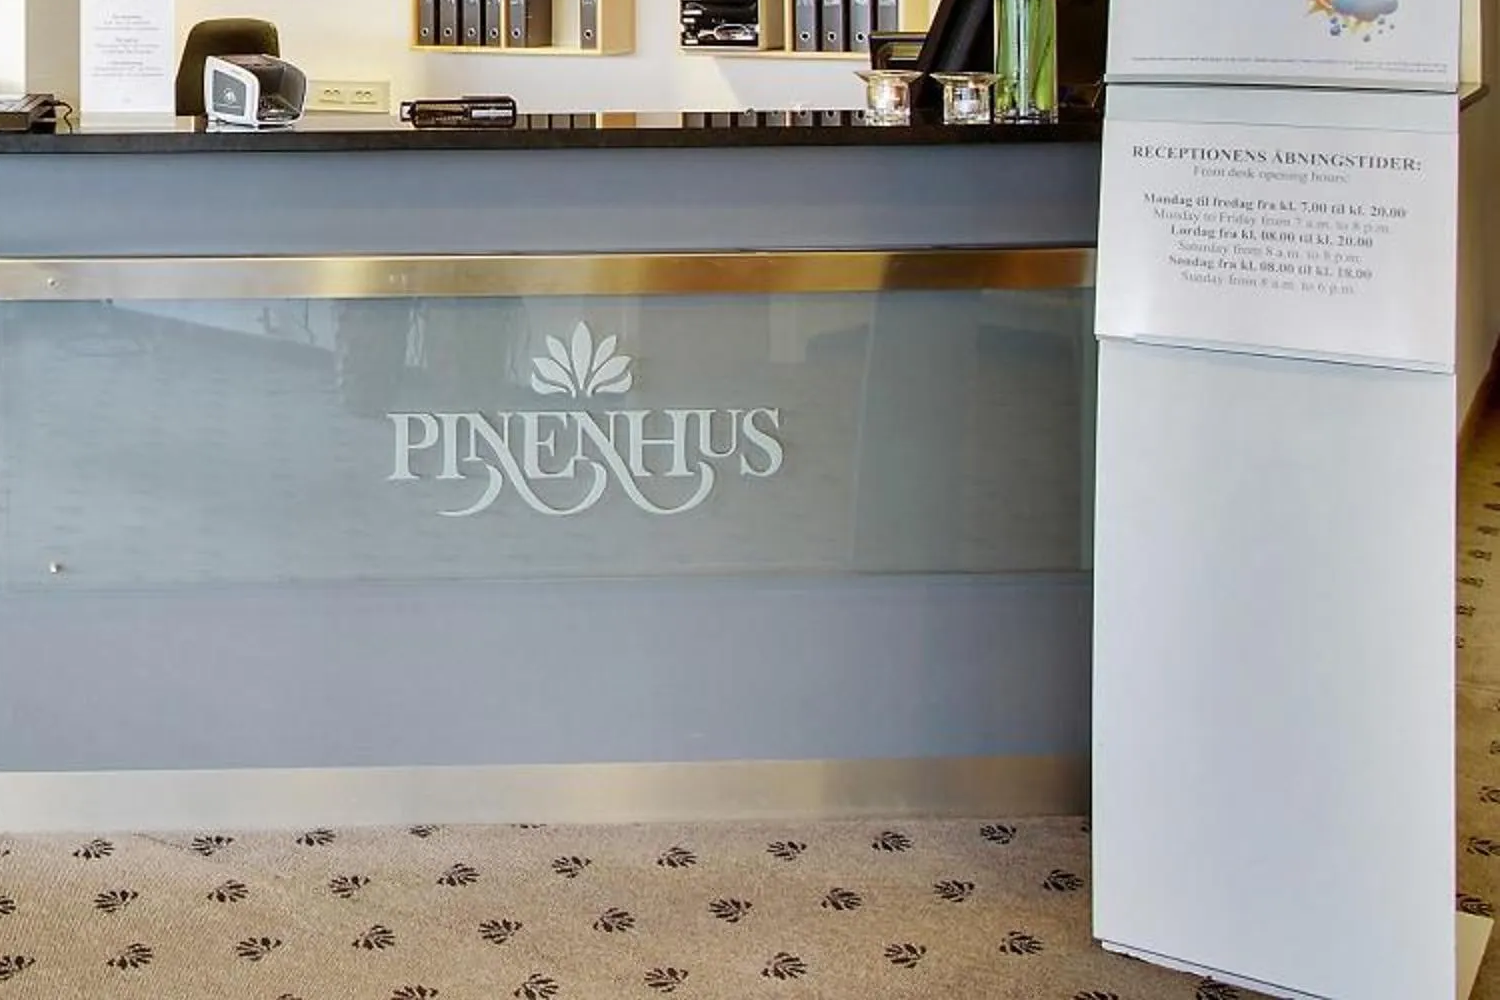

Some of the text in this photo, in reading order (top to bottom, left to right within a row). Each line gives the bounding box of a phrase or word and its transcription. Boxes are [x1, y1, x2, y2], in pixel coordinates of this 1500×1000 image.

[1132, 145, 1422, 171] RECEPTIONENS ÅBNINGSTIDER:
[1192, 165, 1225, 178] Front
[1228, 167, 1254, 178] desk
[1258, 170, 1307, 184] opening
[1143, 192, 1193, 208] Mandag
[1196, 195, 1209, 207] til
[1212, 196, 1253, 211] fredag
[1257, 199, 1276, 210] fra
[1153, 208, 1199, 224] Monday
[1219, 212, 1255, 226] Friday
[1219, 227, 1238, 239] fra
[1177, 241, 1228, 256] Saturday
[1218, 257, 1237, 269] fra
[1180, 270, 1224, 285] Sunday
[385, 407, 784, 517] PINENHUS
